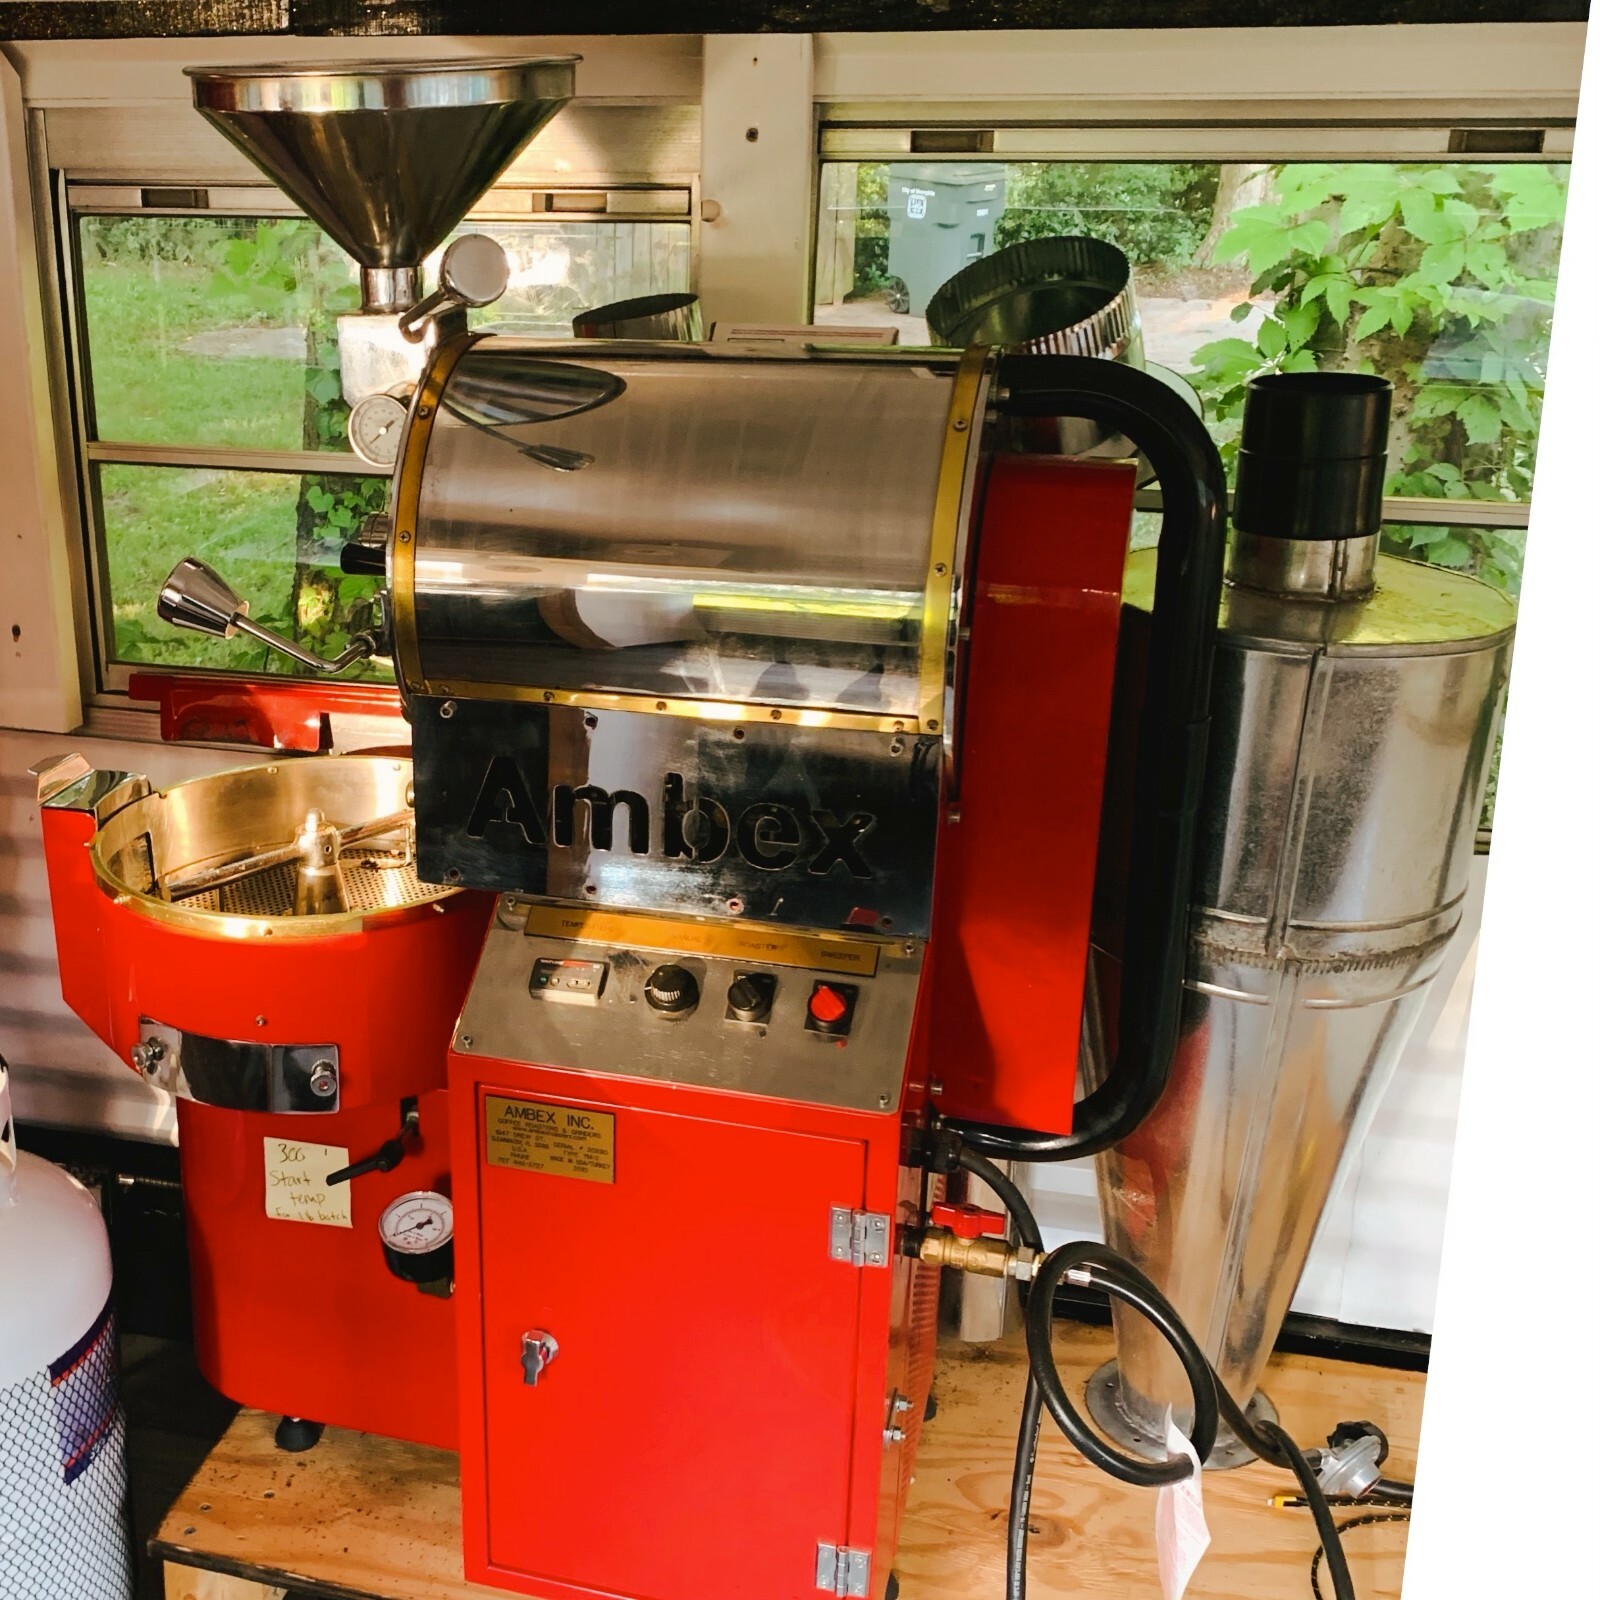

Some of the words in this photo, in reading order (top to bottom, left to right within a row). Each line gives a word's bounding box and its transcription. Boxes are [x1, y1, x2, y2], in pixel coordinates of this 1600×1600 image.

[466, 755, 876, 878] Ambex
[820, 950, 861, 962] SWEEPER
[504, 1105, 556, 1124] AMBEX
[567, 1114, 595, 1130] INC.
[269, 1170, 312, 1188] Start
[290, 1192, 326, 1208] temp
[318, 1209, 348, 1221] batch
